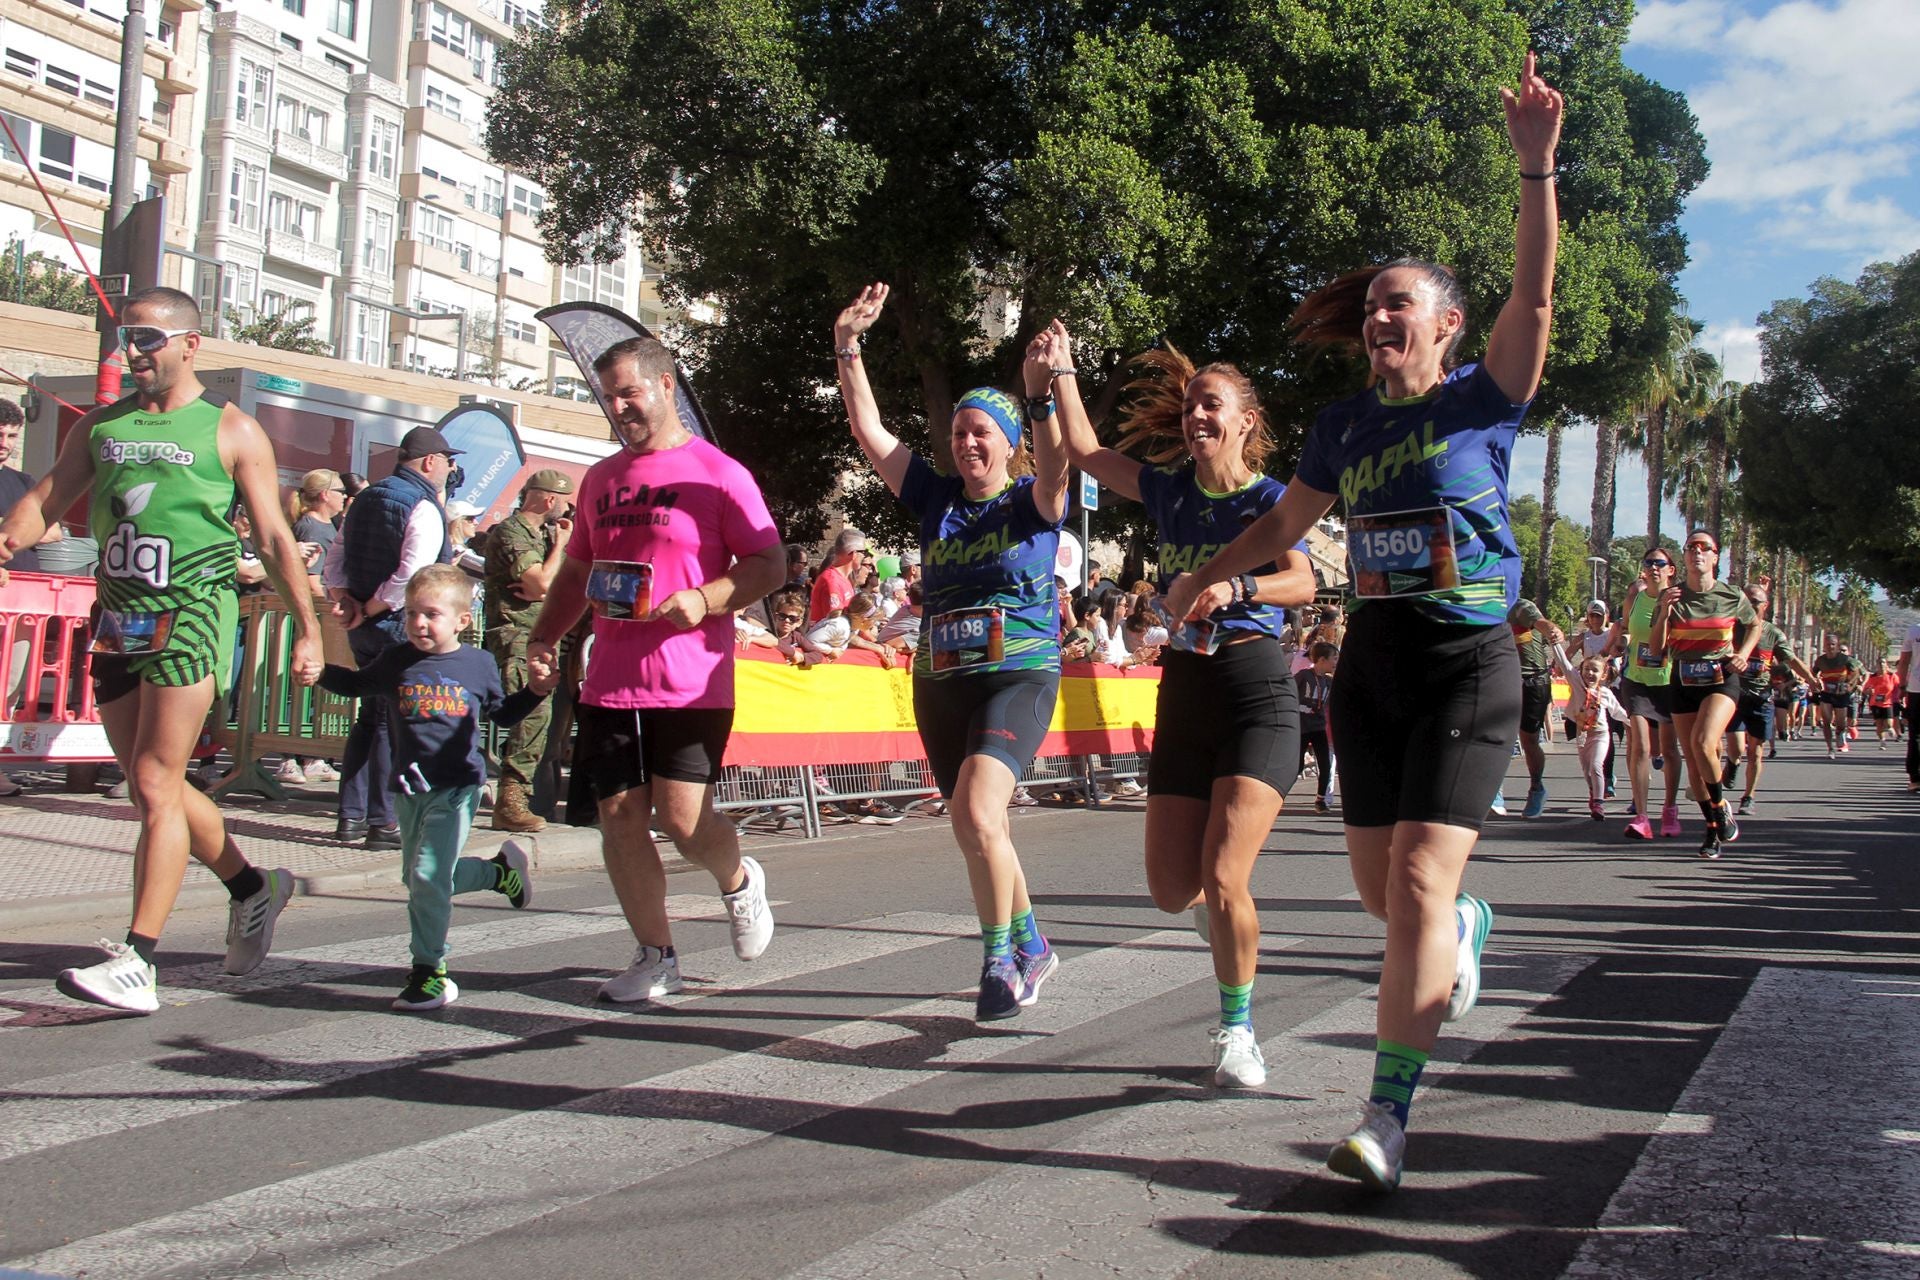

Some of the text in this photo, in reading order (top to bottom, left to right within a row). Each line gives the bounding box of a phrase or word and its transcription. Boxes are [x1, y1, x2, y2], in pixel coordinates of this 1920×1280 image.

[102, 439, 191, 463] dqagro.es
[1339, 420, 1449, 507] RAFAL
[466, 449, 513, 505] DE MURCIA
[596, 484, 680, 516] UCAM
[107, 528, 164, 584] dq
[924, 523, 1020, 566] RAFAL
[1362, 528, 1423, 558] 1560
[1159, 542, 1230, 575] RAF
[604, 573, 622, 592] 14
[940, 619, 984, 642] 1198
[1689, 662, 1709, 674] 746
[398, 684, 464, 698] TOTALLY
[400, 699, 465, 712] AWESOME
